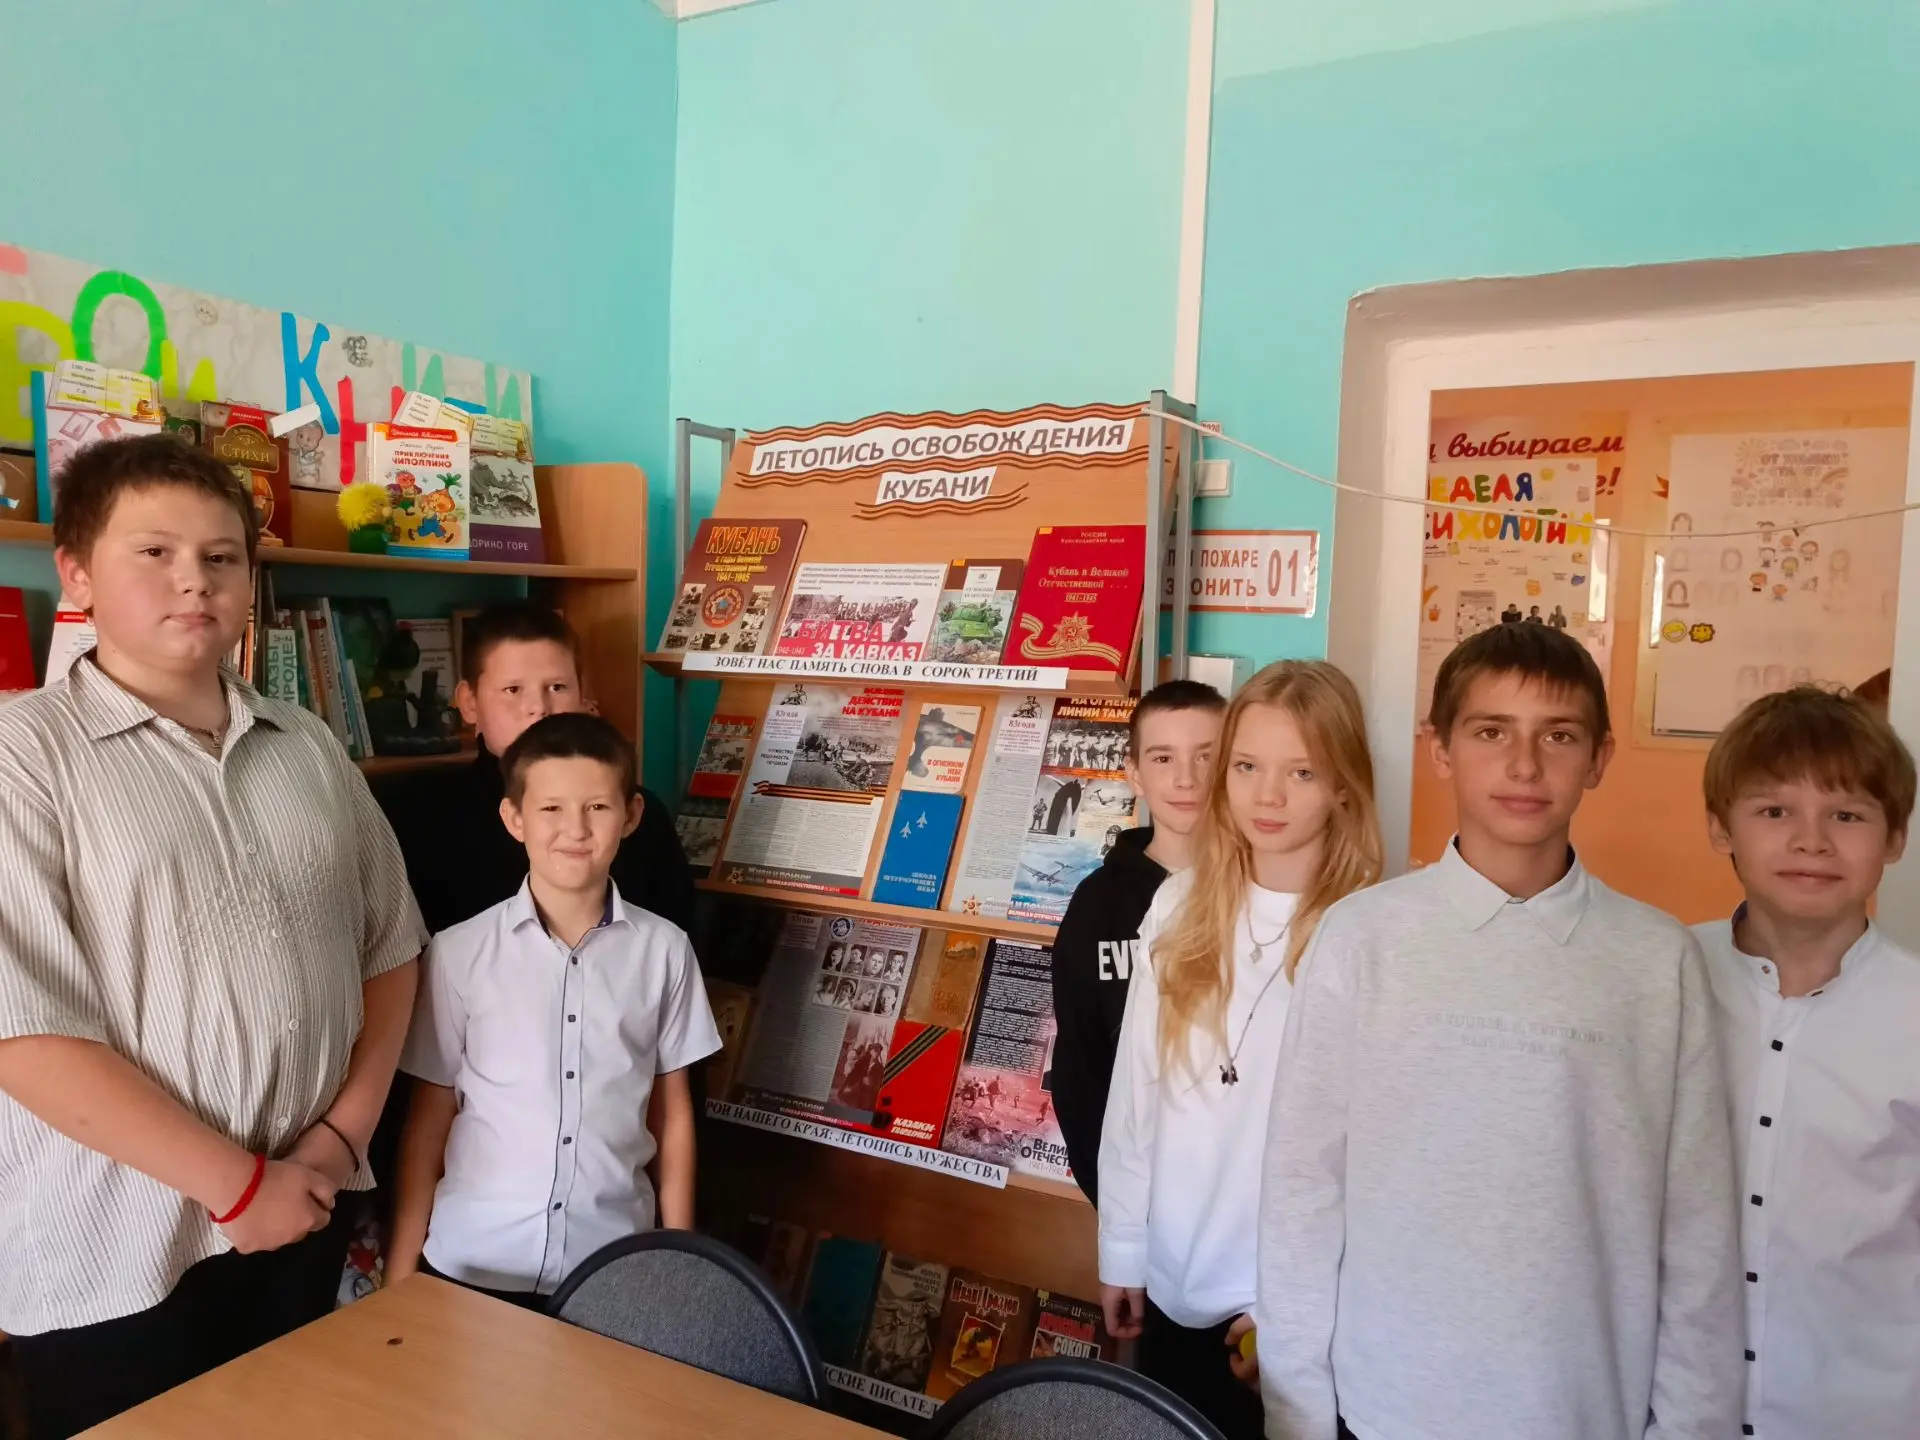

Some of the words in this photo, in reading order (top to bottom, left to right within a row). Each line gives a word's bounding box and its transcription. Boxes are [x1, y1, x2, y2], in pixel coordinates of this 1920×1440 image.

[394, 450, 450, 460] ПРИКЛЮЧЕНИЯ
[756, 443, 885, 472] ЛЕТОПИСЬ
[891, 424, 1126, 459] ОСВОБОЖДЕНИЯ
[1447, 431, 1625, 460] выбираем
[392, 457, 452, 469] ЧИПОЛЛИНО
[882, 475, 991, 500] КУБАНИ
[1428, 472, 1533, 503] ЕДЕЛЯ
[1426, 508, 1595, 545] ИХОЛОГИИ
[506, 540, 529, 551] ГОРЕ
[706, 526, 781, 555] КУБАНЬ
[1200, 549, 1258, 568] ПОЖАРЕ
[1048, 566, 1080, 578] Кубань
[1090, 566, 1129, 577] Великой
[1165, 578, 1257, 597] ЗОНИТЬ
[1267, 549, 1298, 597] 01
[1038, 578, 1105, 589] Отечественной
[799, 619, 884, 643] БИТВА
[812, 642, 835, 659] ЗА
[840, 643, 918, 661] КАВКАЗ
[714, 654, 757, 670] ЗОВЁТ
[757, 657, 786, 672] НАС
[788, 659, 848, 677] ПАМЯТЬ
[850, 662, 899, 678] СНОВА
[901, 664, 912, 678] В
[921, 665, 968, 681] СОРОК
[970, 666, 1038, 683] ТРЕТИЙ
[842, 706, 857, 715] НА
[857, 707, 901, 718] КУБАНИ
[848, 696, 903, 707] ДЕЙСТВИЯ
[1057, 706, 1101, 717] ЛИНИИ
[1071, 697, 1088, 705] НА
[1098, 939, 1141, 981] EV
[734, 1106, 791, 1129] НАШЕГО
[794, 1122, 833, 1141] КРАЯ:
[836, 1132, 913, 1158] ЛЕТОПИСЬ
[916, 1149, 1002, 1181] МУЖЕСТВА
[1021, 1146, 1070, 1168] ОТЕЧЕСТ
